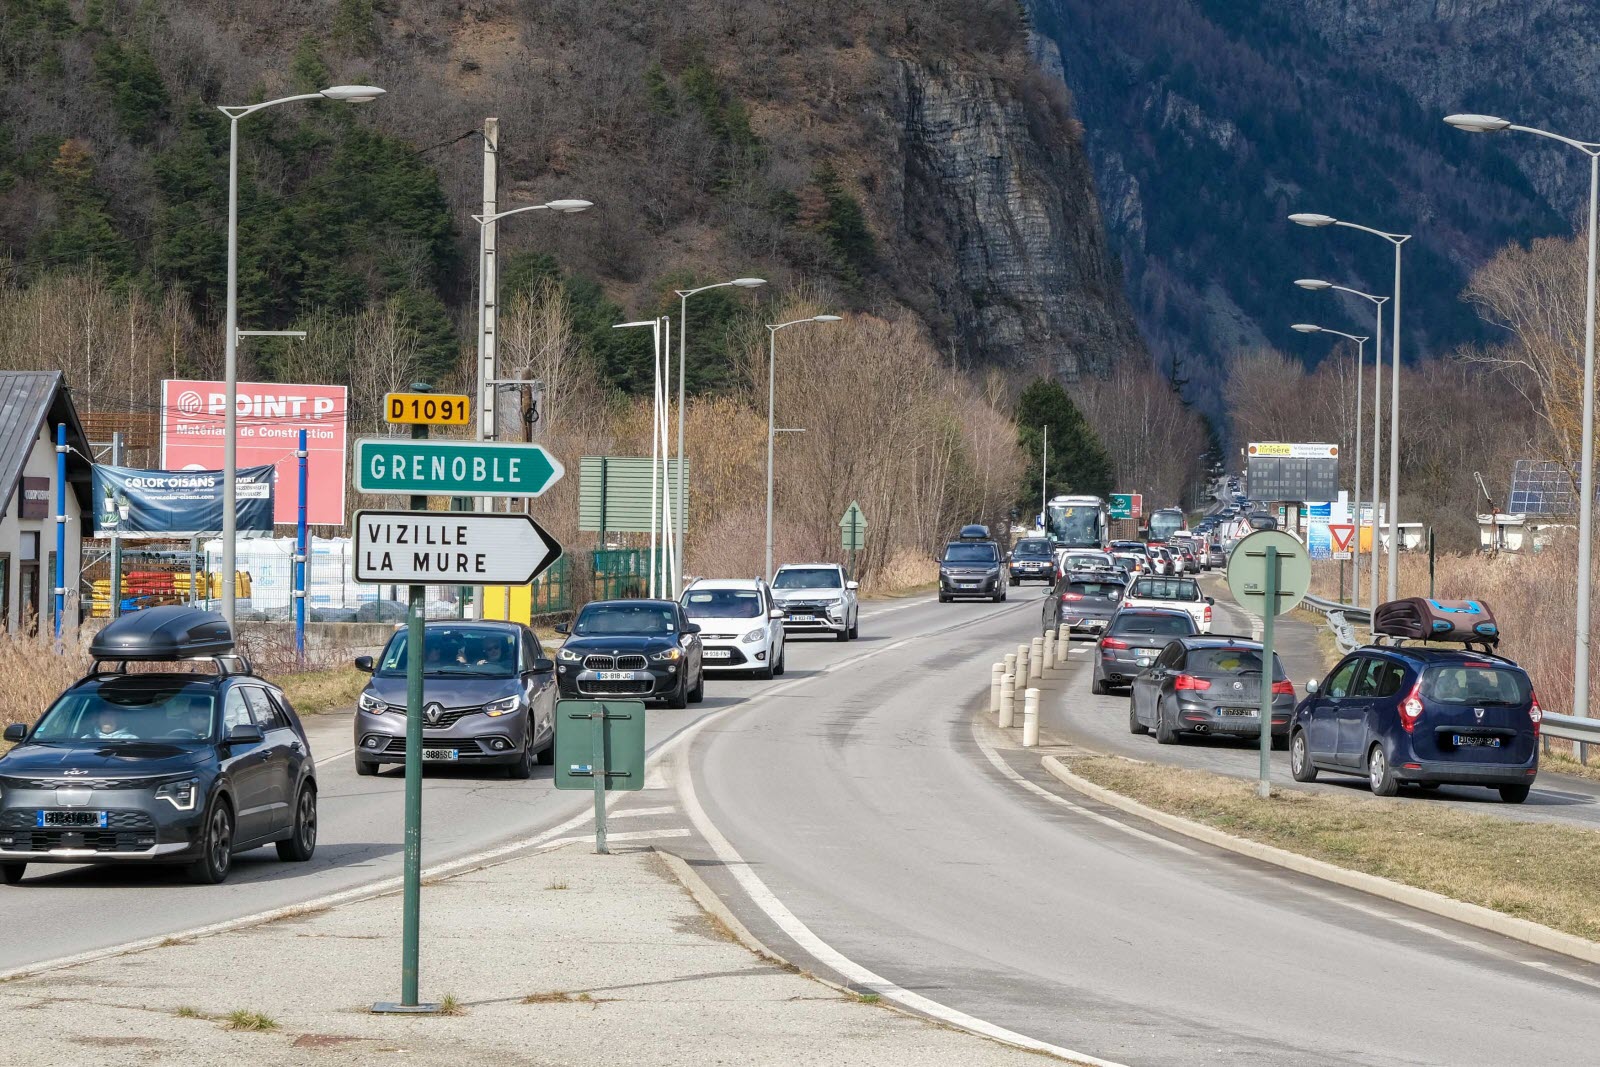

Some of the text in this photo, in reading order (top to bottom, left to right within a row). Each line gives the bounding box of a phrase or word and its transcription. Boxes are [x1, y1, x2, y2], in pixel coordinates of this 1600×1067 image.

[176, 424, 334, 439] Matéria de Constrction
[370, 454, 521, 483] GRENOBLE
[368, 524, 468, 546] VIZILLE
[366, 551, 487, 573] LA MURE
